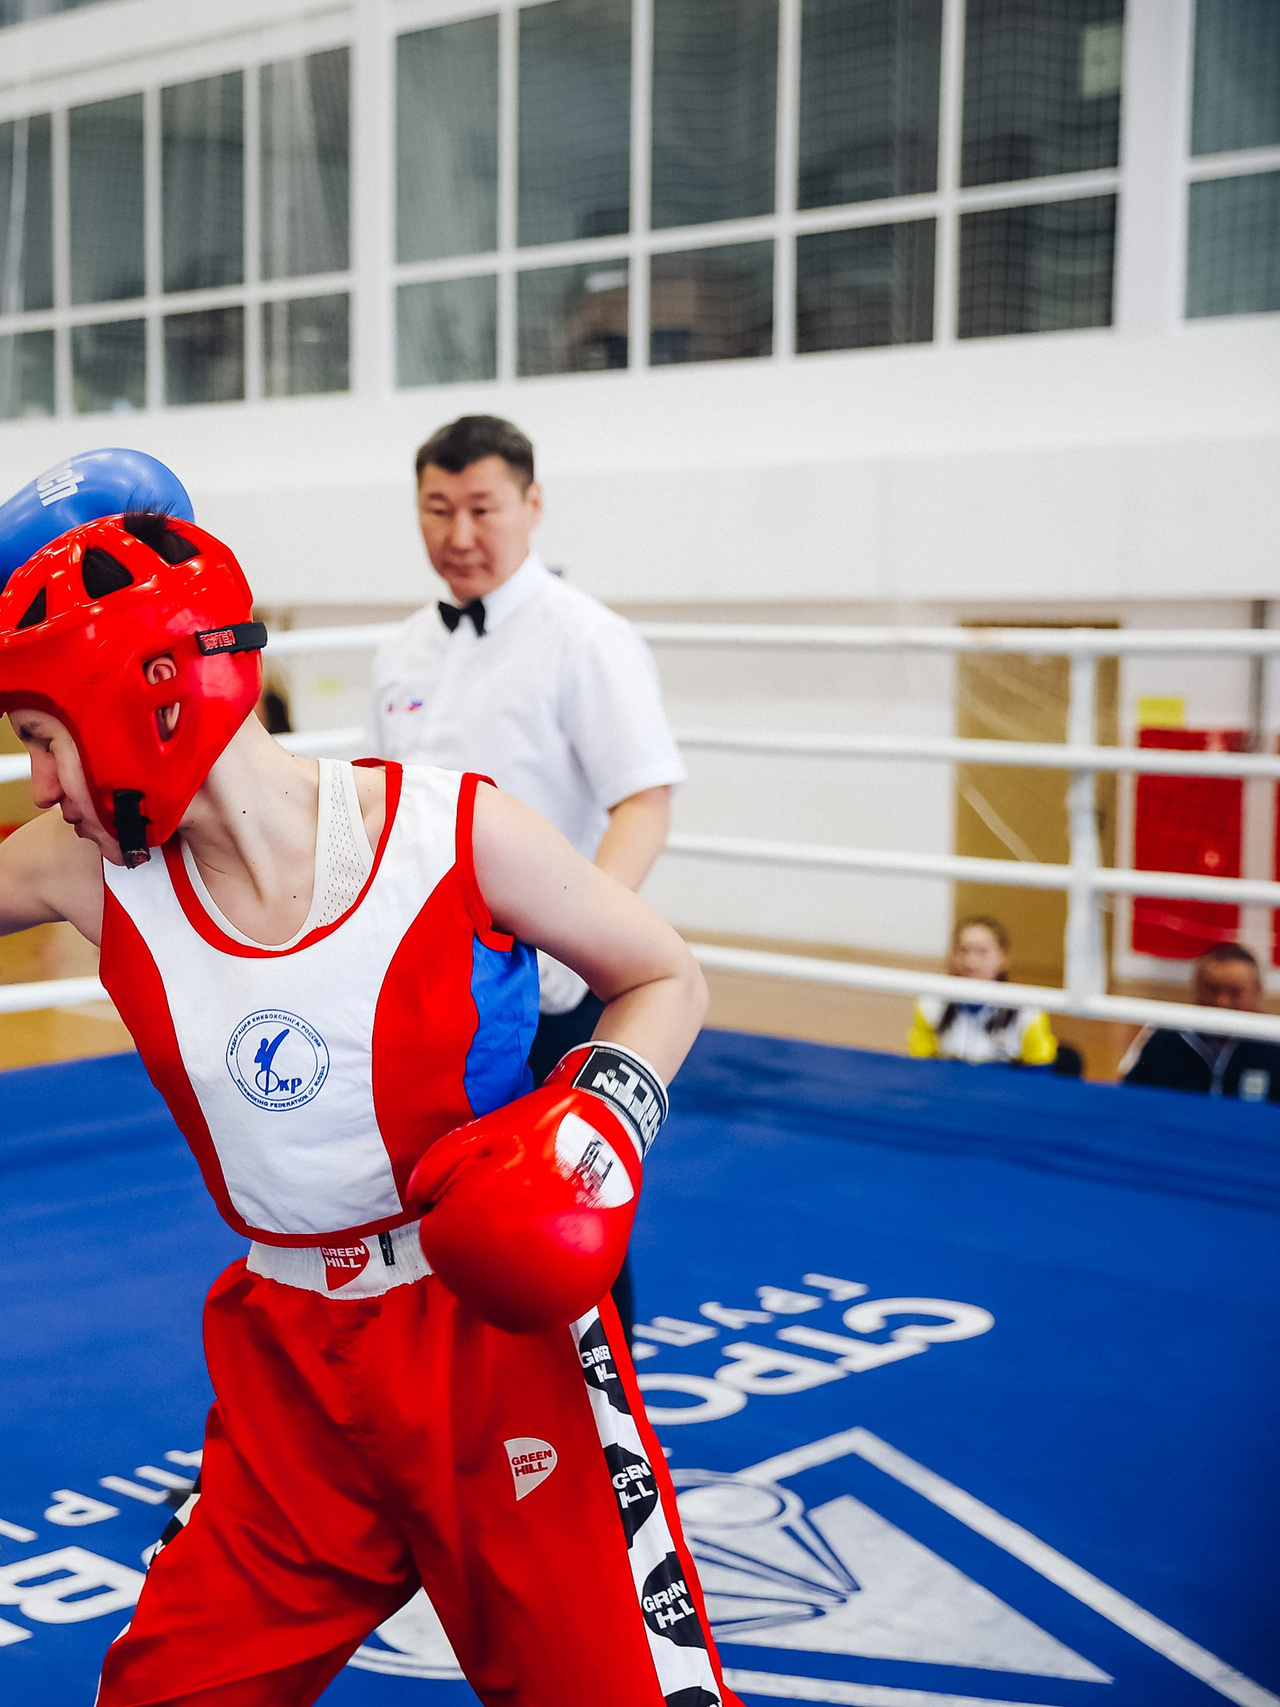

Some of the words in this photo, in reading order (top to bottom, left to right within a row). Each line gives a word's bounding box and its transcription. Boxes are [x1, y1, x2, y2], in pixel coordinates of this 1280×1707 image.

[322, 1245, 366, 1257] GREEN
[325, 1257, 362, 1268] HILL
[511, 1449, 553, 1466] GREEN
[514, 1461, 548, 1477] HILL
